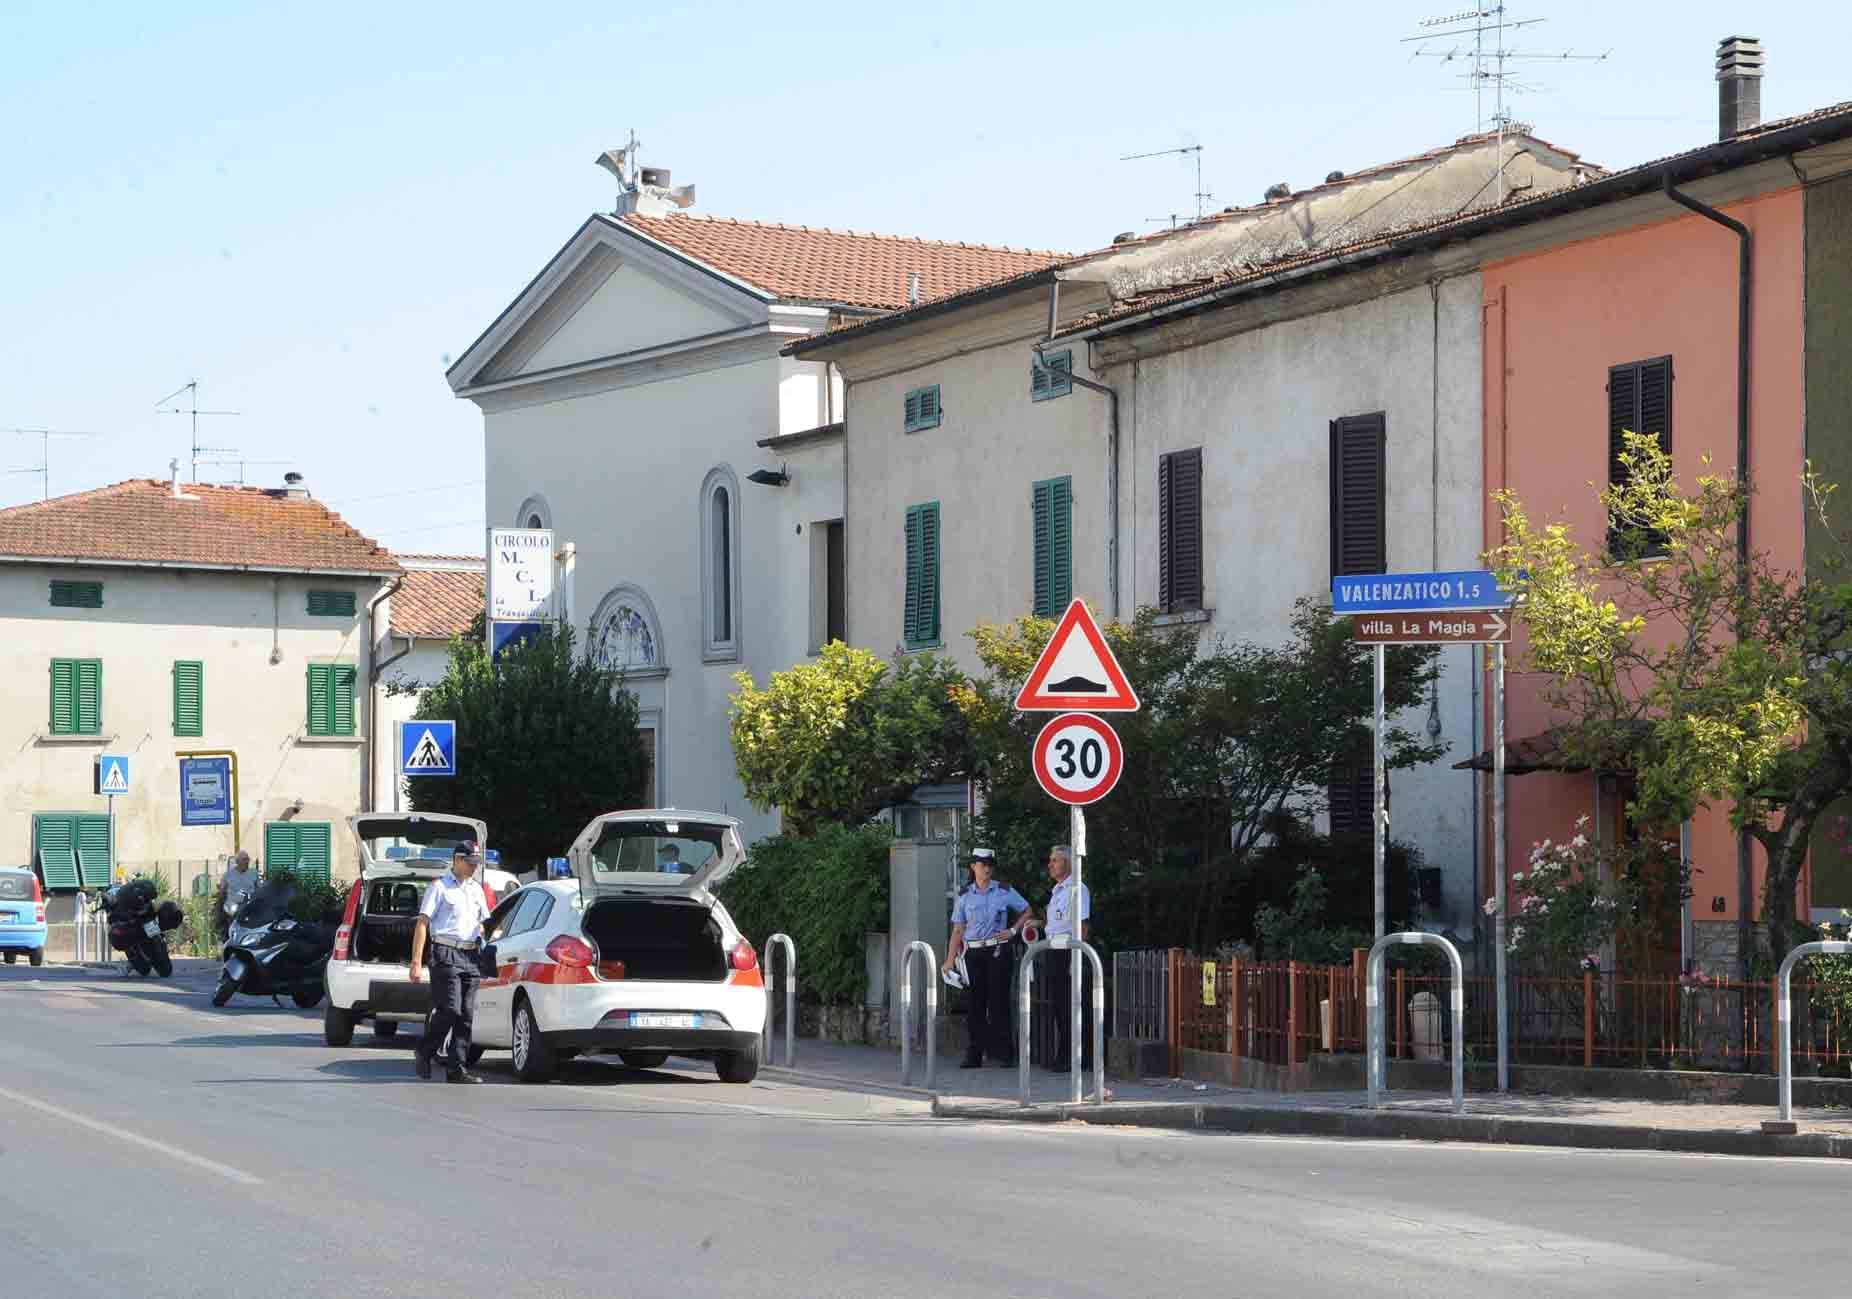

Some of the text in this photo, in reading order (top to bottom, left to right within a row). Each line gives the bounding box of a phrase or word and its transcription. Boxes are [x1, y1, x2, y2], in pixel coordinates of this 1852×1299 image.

[495, 535, 550, 547] CIRCOLO
[501, 551, 524, 564] M.
[1341, 581, 1481, 602] VALENZATICO 1.5
[1361, 619, 1476, 636] villa La Magia
[1054, 738, 1103, 779] 30
